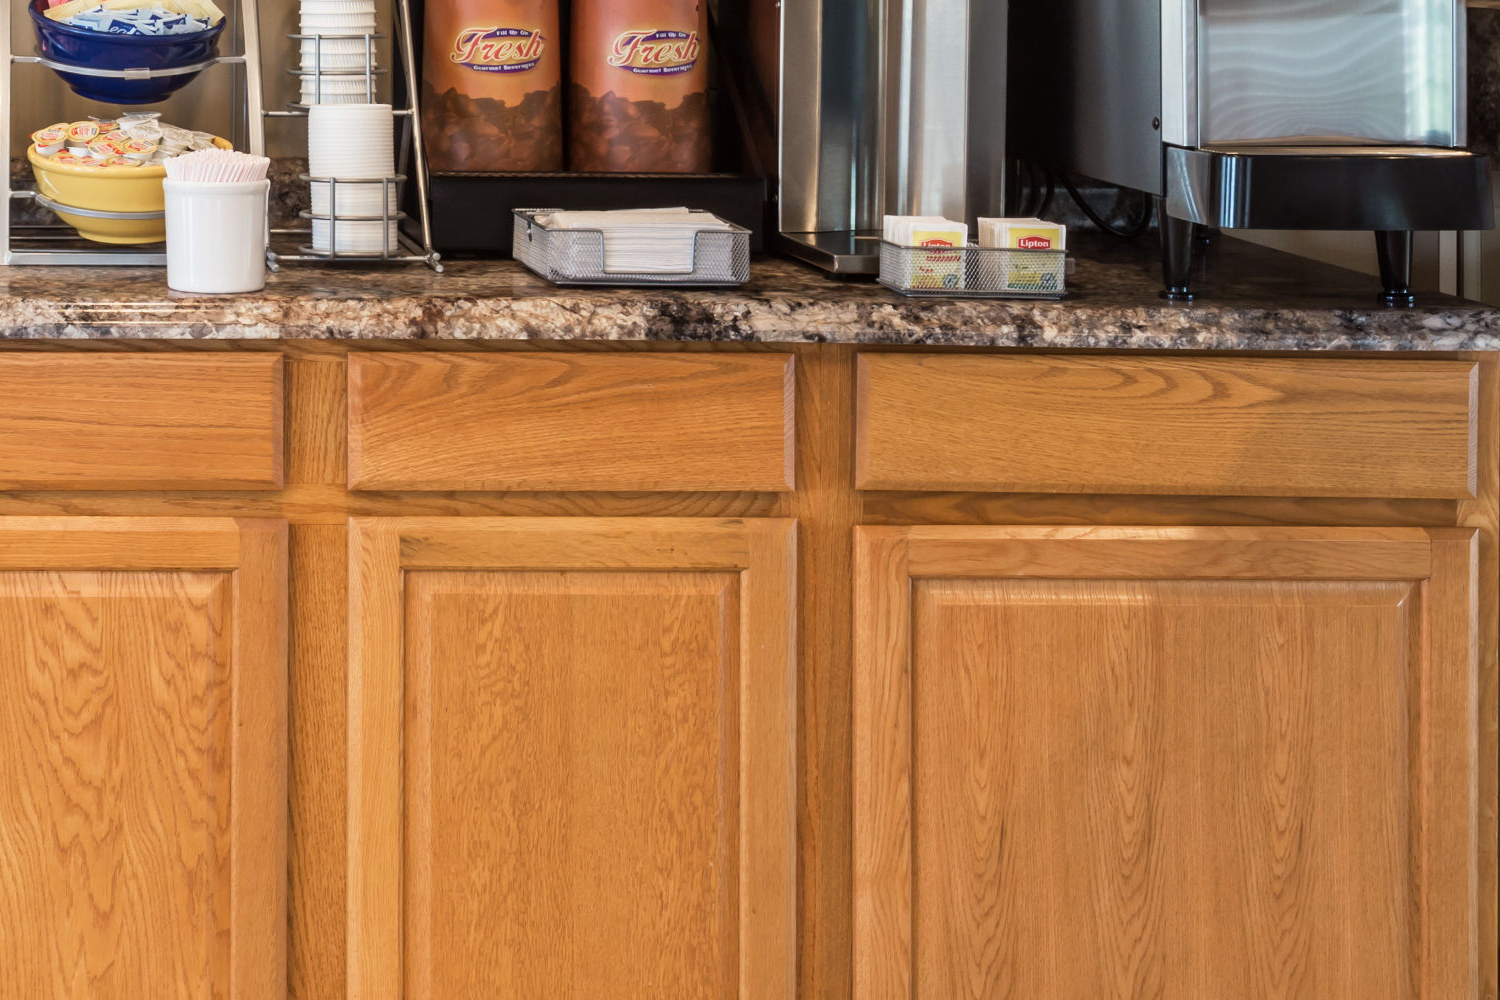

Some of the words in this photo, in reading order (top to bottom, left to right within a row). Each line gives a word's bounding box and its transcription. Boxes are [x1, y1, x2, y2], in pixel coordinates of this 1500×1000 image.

[450, 26, 544, 63] Fresh
[607, 29, 700, 67] Fresh
[1020, 240, 1049, 249] Lipton
